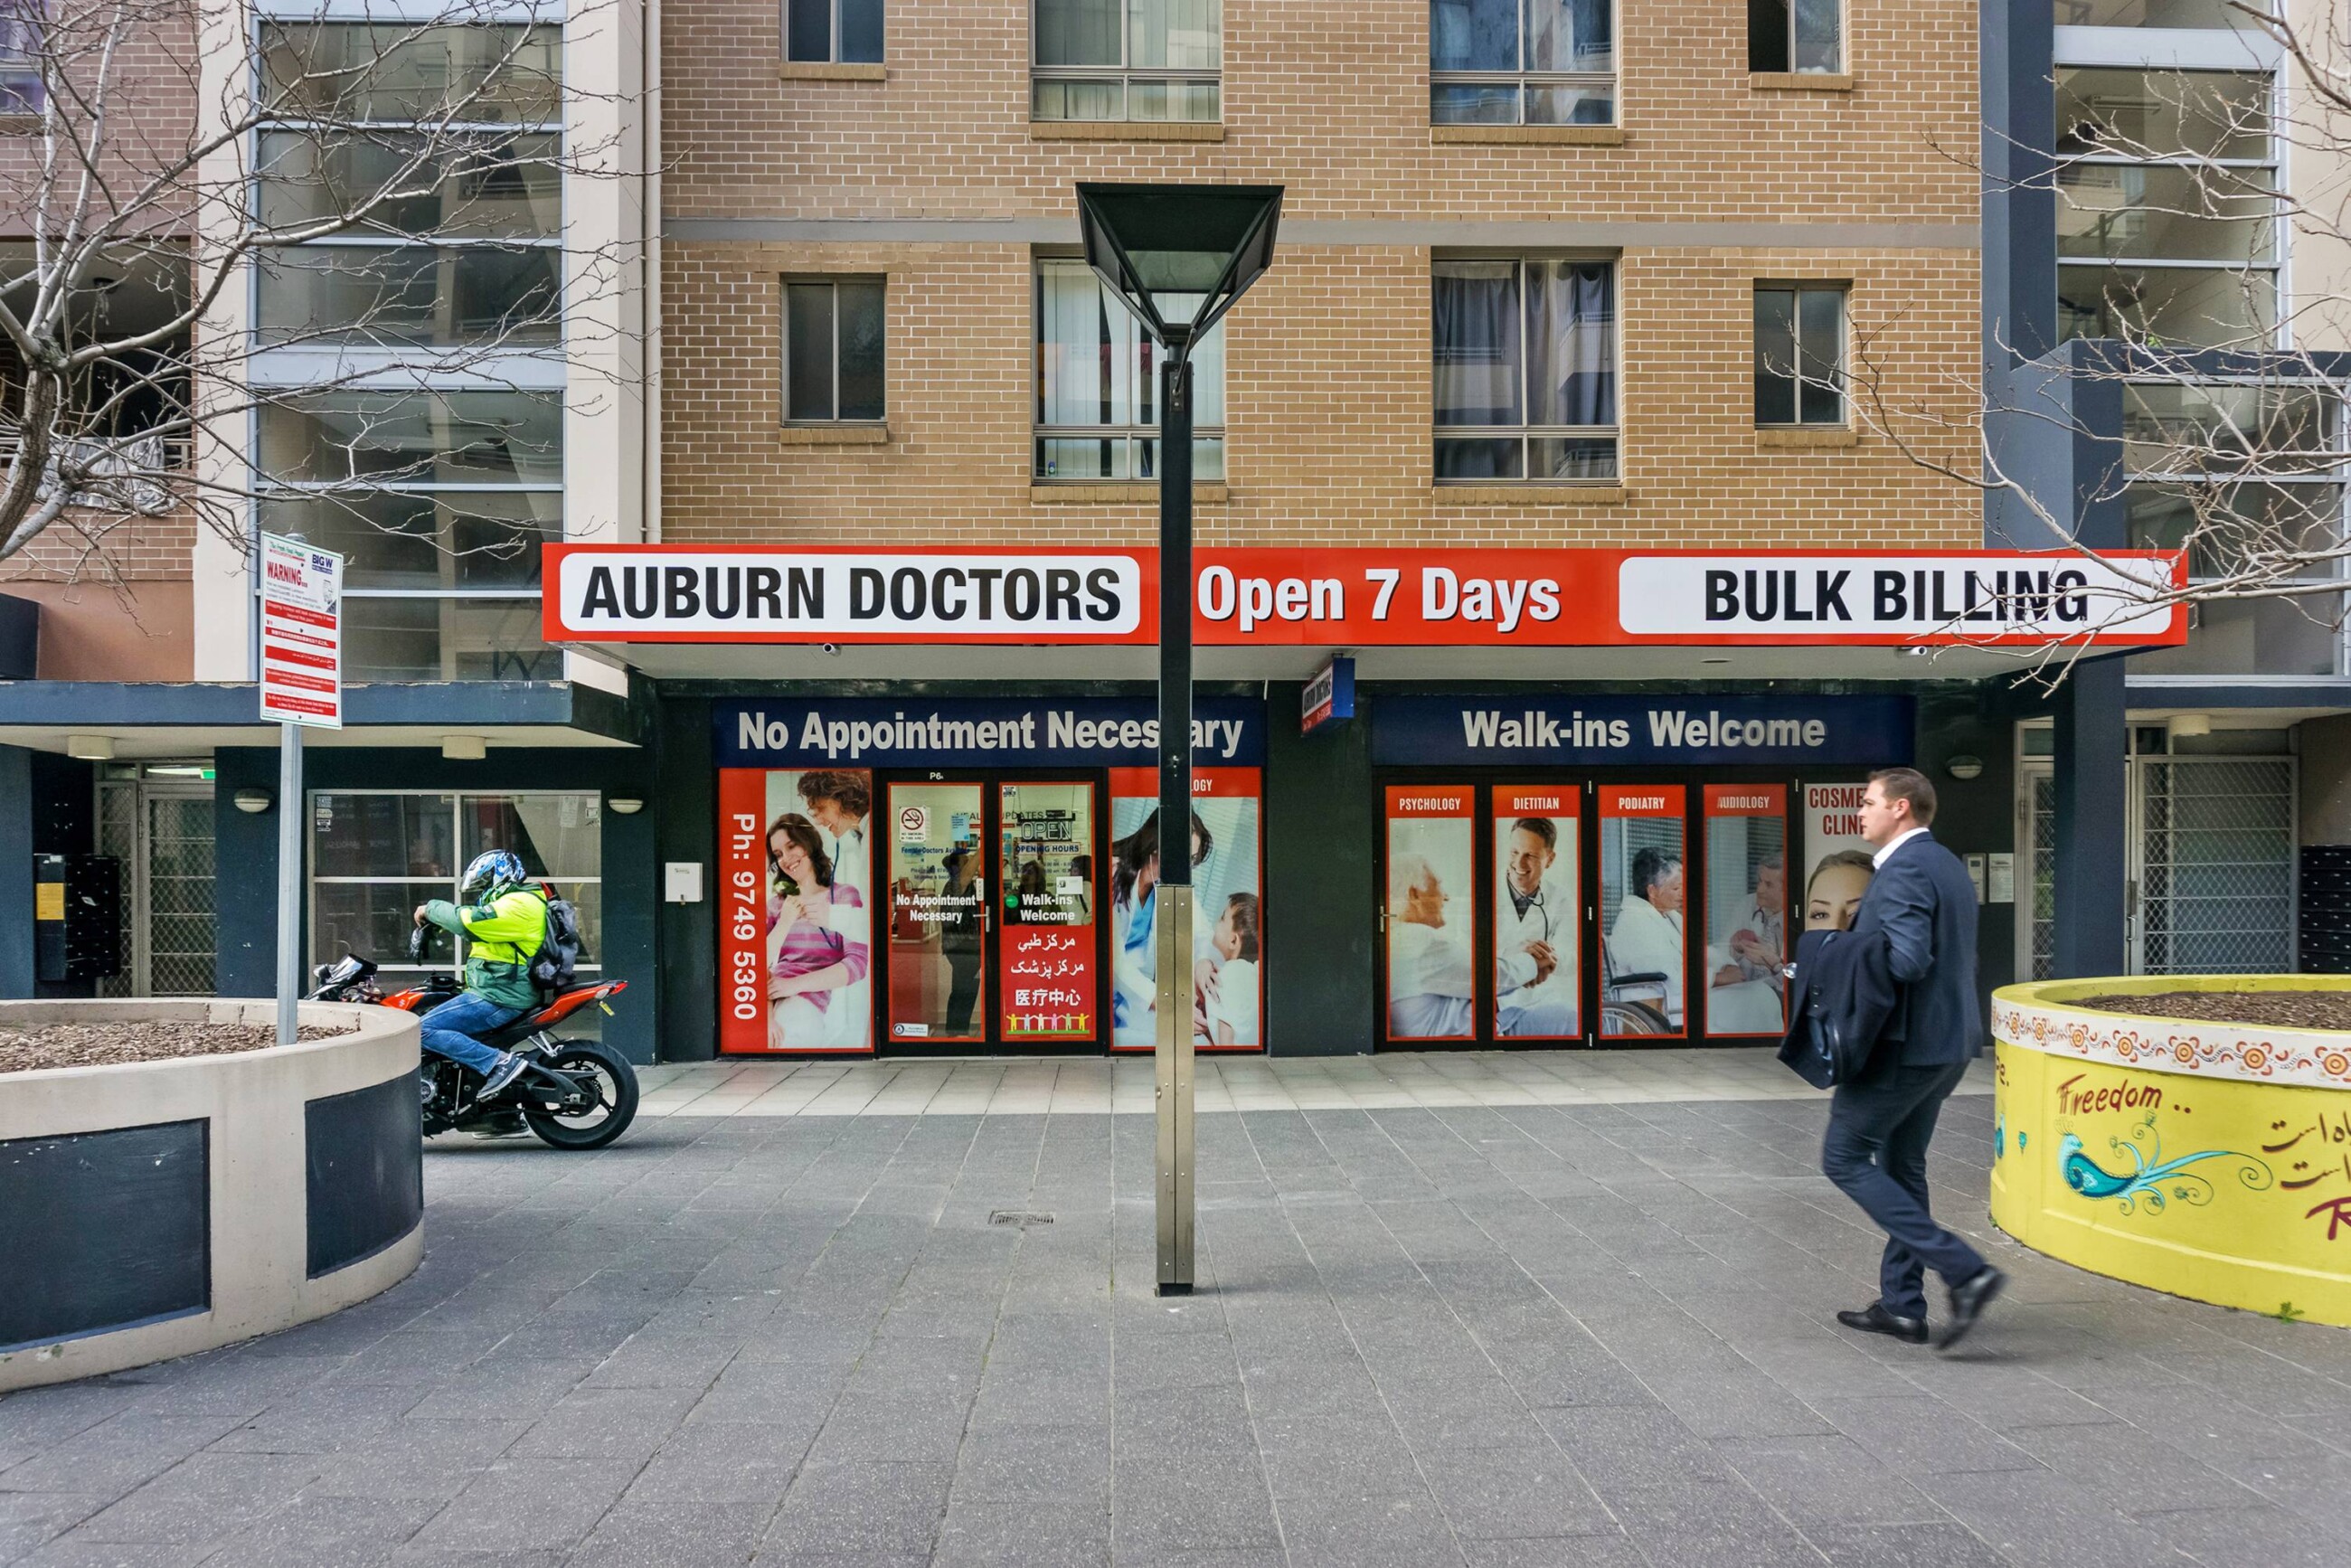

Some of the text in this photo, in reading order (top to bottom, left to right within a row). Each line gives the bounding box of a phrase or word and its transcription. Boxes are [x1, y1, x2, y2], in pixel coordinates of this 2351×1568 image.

[312, 553, 325, 566] BIG
[326, 558, 334, 568] W
[580, 566, 1120, 622] AUBURN DOCTORS
[1197, 565, 1562, 633] Open 7 Days
[1704, 570, 2089, 622] BULK BILLING
[738, 711, 1244, 760] No Appointment Necesary
[1462, 710, 1828, 748] Walk-ins Welcome
[1399, 797, 1461, 811] PSYCHOLOGY
[1513, 797, 1560, 810] DIETITIAN
[1618, 797, 1666, 810] PODIATRY
[1717, 796, 1770, 809] AUDIOLOGY
[1809, 787, 1867, 808] COSME
[1022, 821, 1072, 841] OPEN
[1053, 845, 1080, 853] HOURS
[896, 893, 976, 908] No Appointment
[1022, 893, 1073, 906] Walk-ins
[732, 814, 757, 1020] Ph: 9749 5360
[910, 909, 963, 924] Necessary
[1020, 909, 1076, 921] Welcome
[1017, 933, 1042, 952] طبي
[1015, 988, 1081, 1006] 医疗中心
[2056, 1073, 2163, 1116] Freedom
